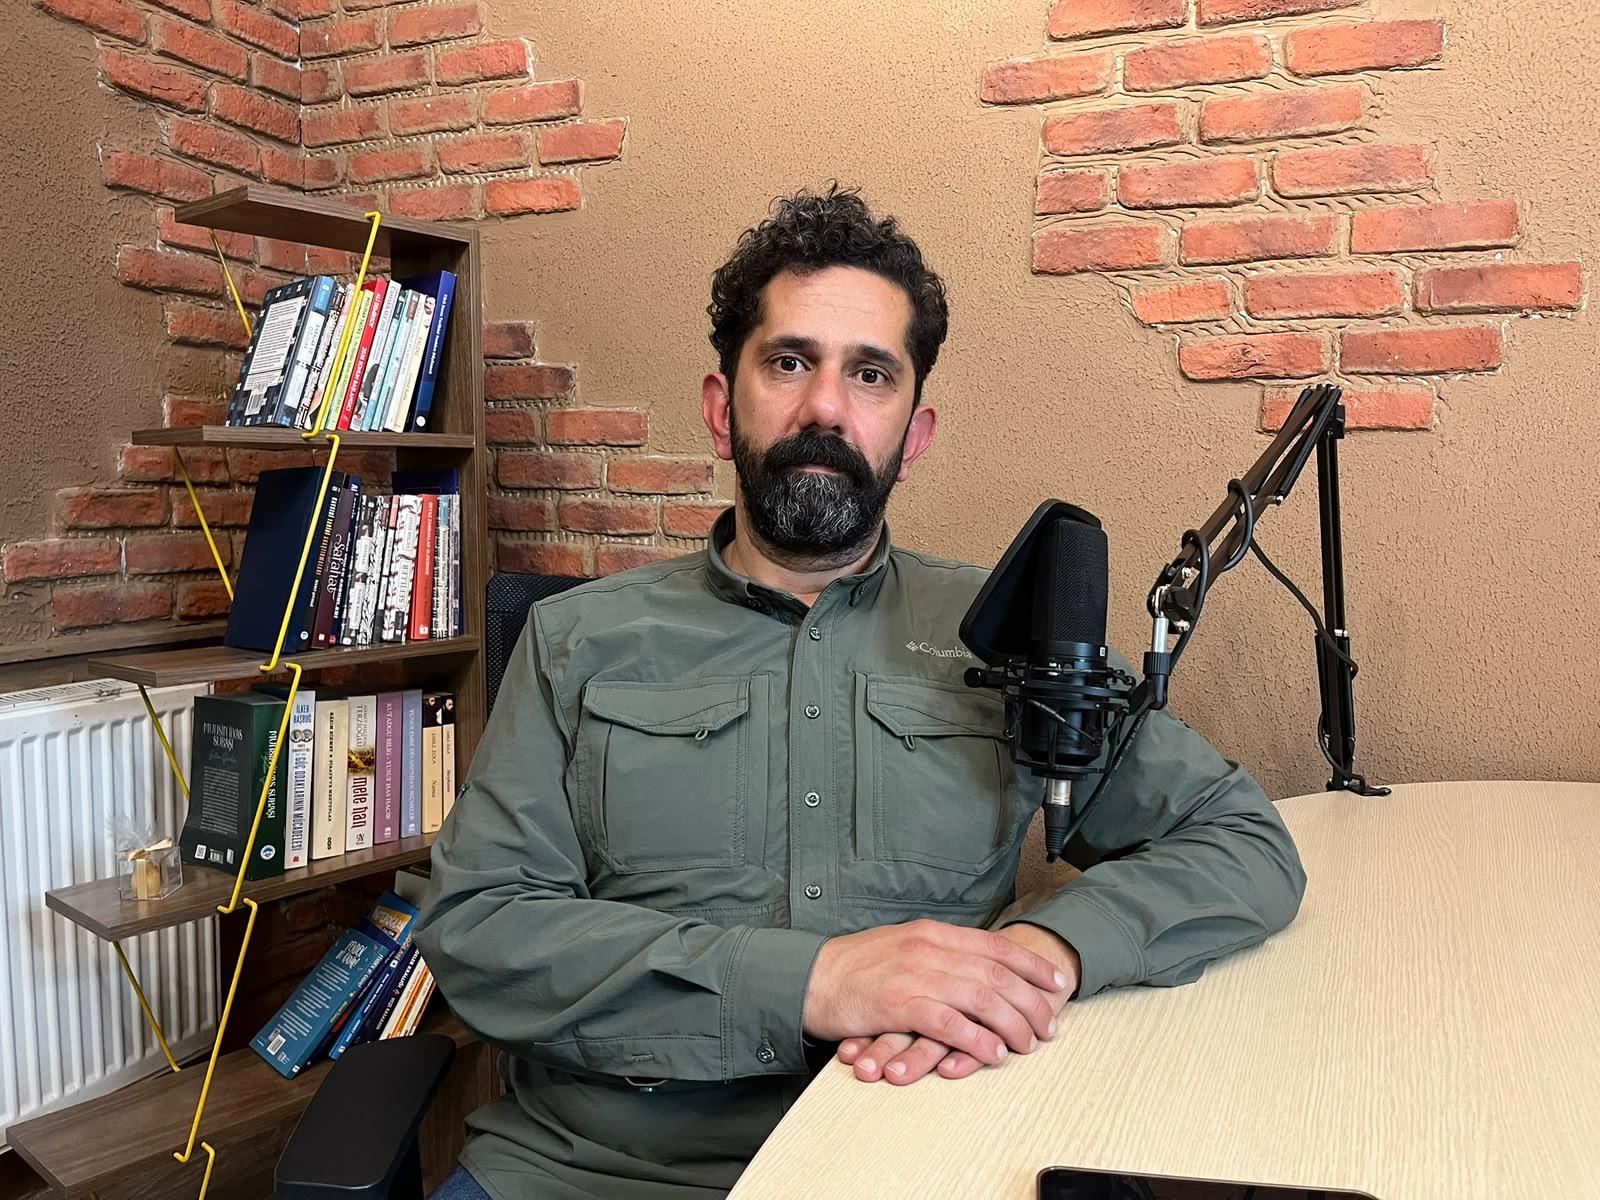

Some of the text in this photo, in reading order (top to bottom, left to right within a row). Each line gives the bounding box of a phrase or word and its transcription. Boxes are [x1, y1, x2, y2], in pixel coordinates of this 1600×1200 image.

[327, 534, 346, 600] Safahat
[919, 642, 972, 659] Columbia
[296, 704, 310, 713] İLKER
[292, 769, 306, 811] ODAKLARININ
[290, 812, 305, 851] MÜCADELESİ
[351, 806, 368, 829] han
